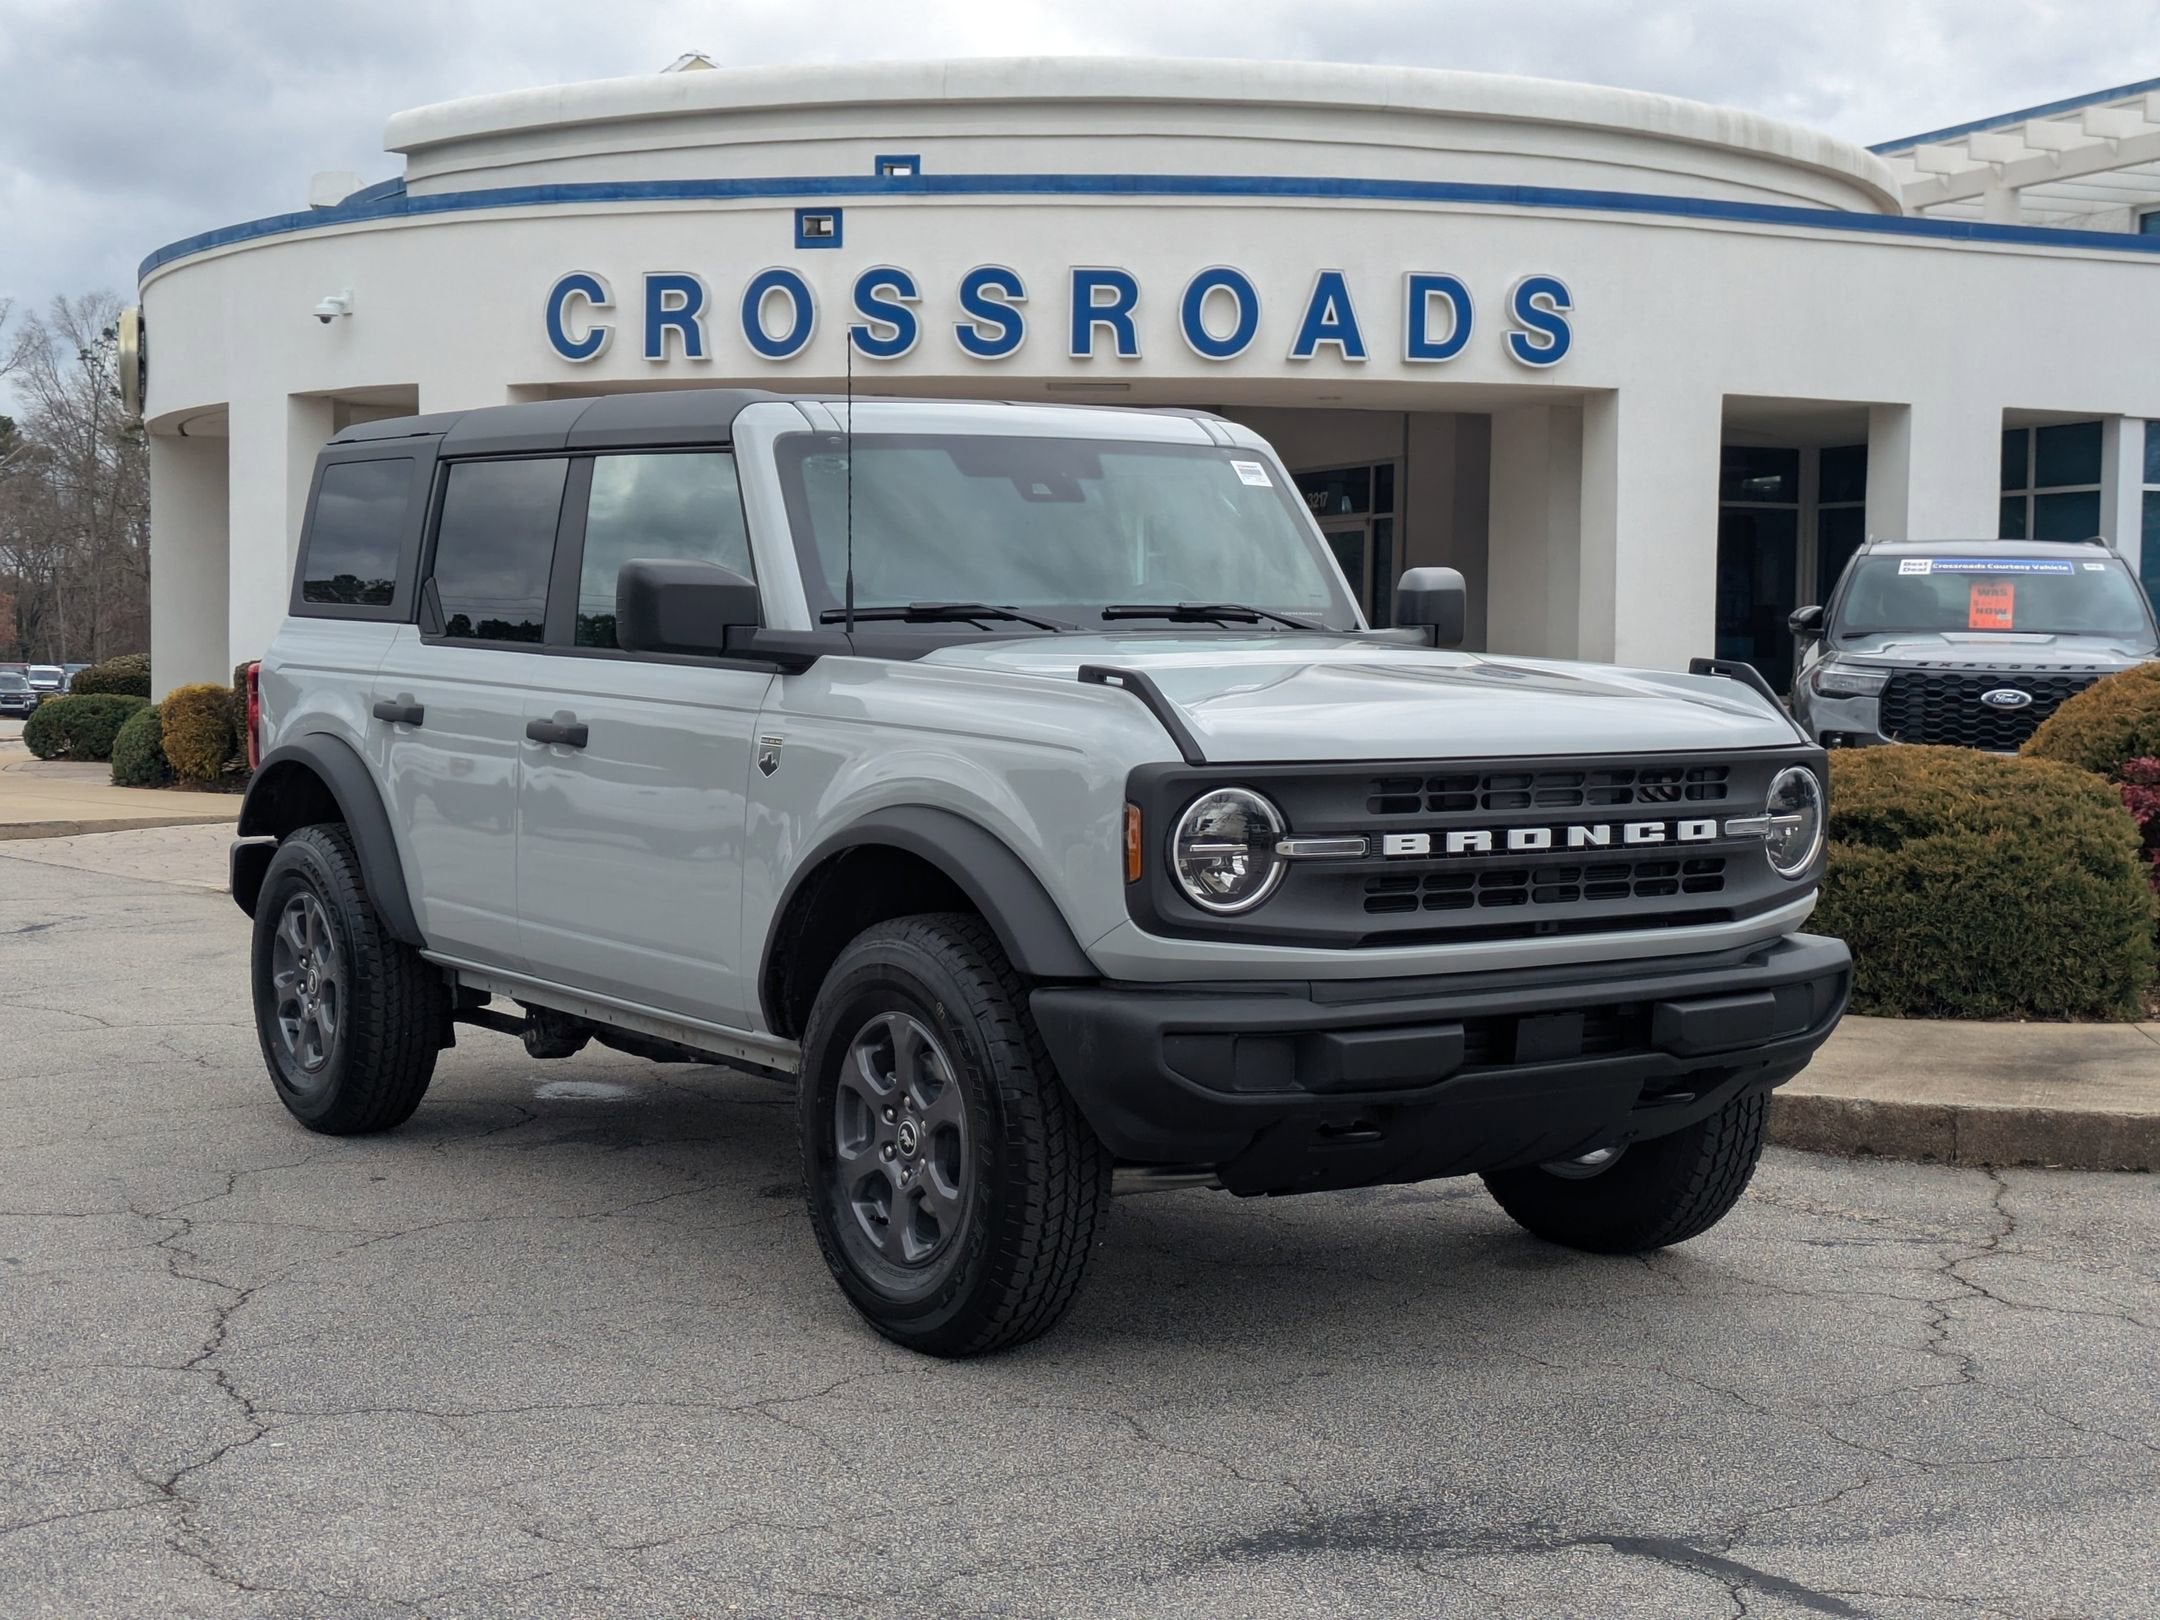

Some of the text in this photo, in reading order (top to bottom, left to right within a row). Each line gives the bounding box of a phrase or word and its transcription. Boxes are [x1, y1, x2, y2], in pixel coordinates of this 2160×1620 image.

[545, 264, 1574, 368] CROSSROADS
[1987, 563, 2030, 571] Courtesy
[1976, 588, 2008, 597] WAS
[1975, 607, 2007, 615] NOW
[1916, 661, 2097, 671] EXPLORER
[1383, 819, 1717, 856] BRONCO
